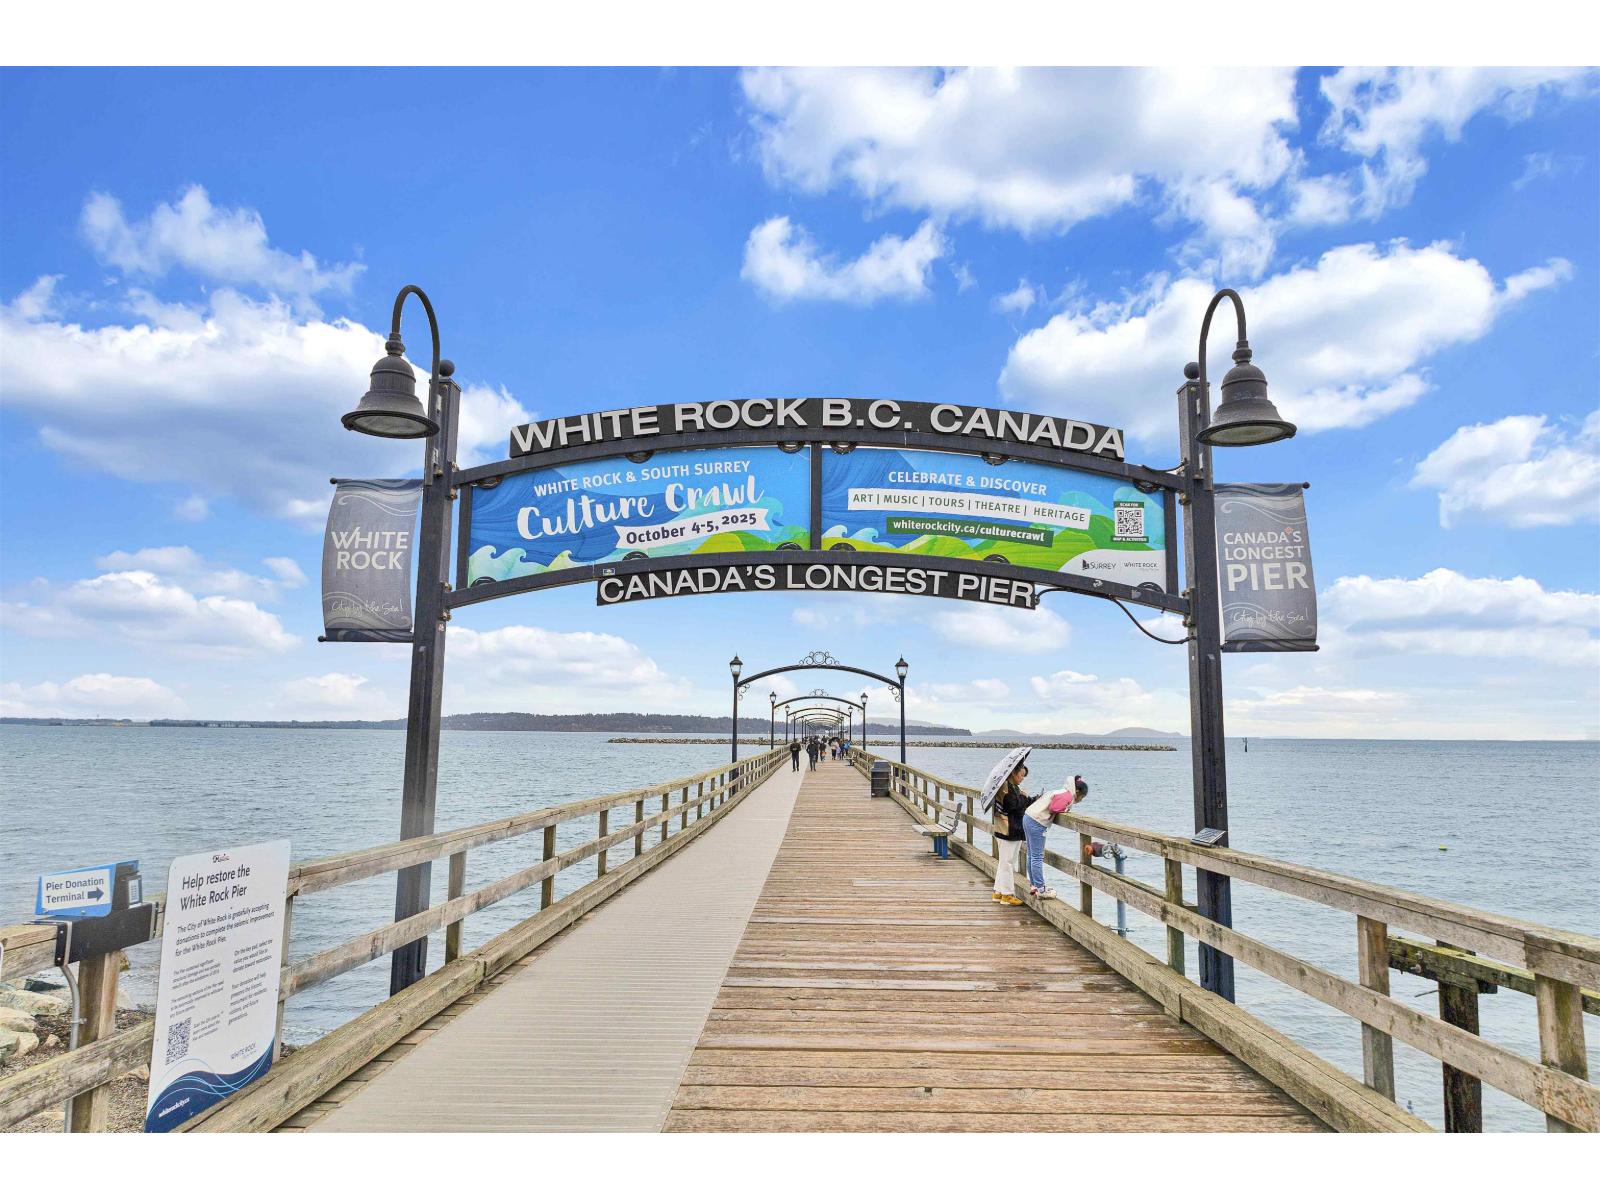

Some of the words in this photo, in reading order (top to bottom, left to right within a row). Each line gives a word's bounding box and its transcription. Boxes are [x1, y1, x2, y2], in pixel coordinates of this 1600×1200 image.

[511, 406, 660, 452] WHITE
[674, 398, 808, 431] ROCK
[822, 398, 912, 429] B.C.
[930, 404, 1125, 458] CANADA
[533, 480, 580, 497] WHITE
[582, 473, 623, 489] ROCK
[626, 472, 636, 483] &
[641, 465, 690, 481] SOUTH
[694, 460, 750, 475] SURREY
[888, 471, 962, 487] CELEBRATE
[966, 476, 976, 487] &
[980, 476, 1047, 496] DISCOVER
[517, 495, 655, 540] Culture
[665, 475, 764, 513] Crawl
[852, 494, 874, 503] ART
[883, 495, 918, 505] MUSIC
[929, 496, 965, 508] TOURS
[974, 500, 1021, 514] THEATRE
[1033, 506, 1086, 523] HERITAGE
[331, 526, 409, 549] WHITE
[626, 524, 686, 544] October
[691, 521, 719, 535] 4-5,
[722, 511, 757, 526] 2025
[893, 520, 1045, 542] whiterockcity.ca/culturecrawl
[336, 551, 403, 570] ROCK
[1225, 545, 1304, 561] LONGEST
[600, 564, 776, 602] CANADA'S
[786, 564, 948, 595] LONGEST
[958, 574, 1035, 607] PIER
[1227, 561, 1309, 592] PIER
[46, 882, 63, 891] Pier
[65, 877, 104, 889] Donation
[182, 873, 204, 891] Help
[206, 869, 235, 885] restore
[237, 864, 250, 877] the
[46, 891, 84, 904] Terminal
[180, 895, 206, 911] White
[209, 886, 229, 904] Rock
[231, 884, 248, 899] Pier
